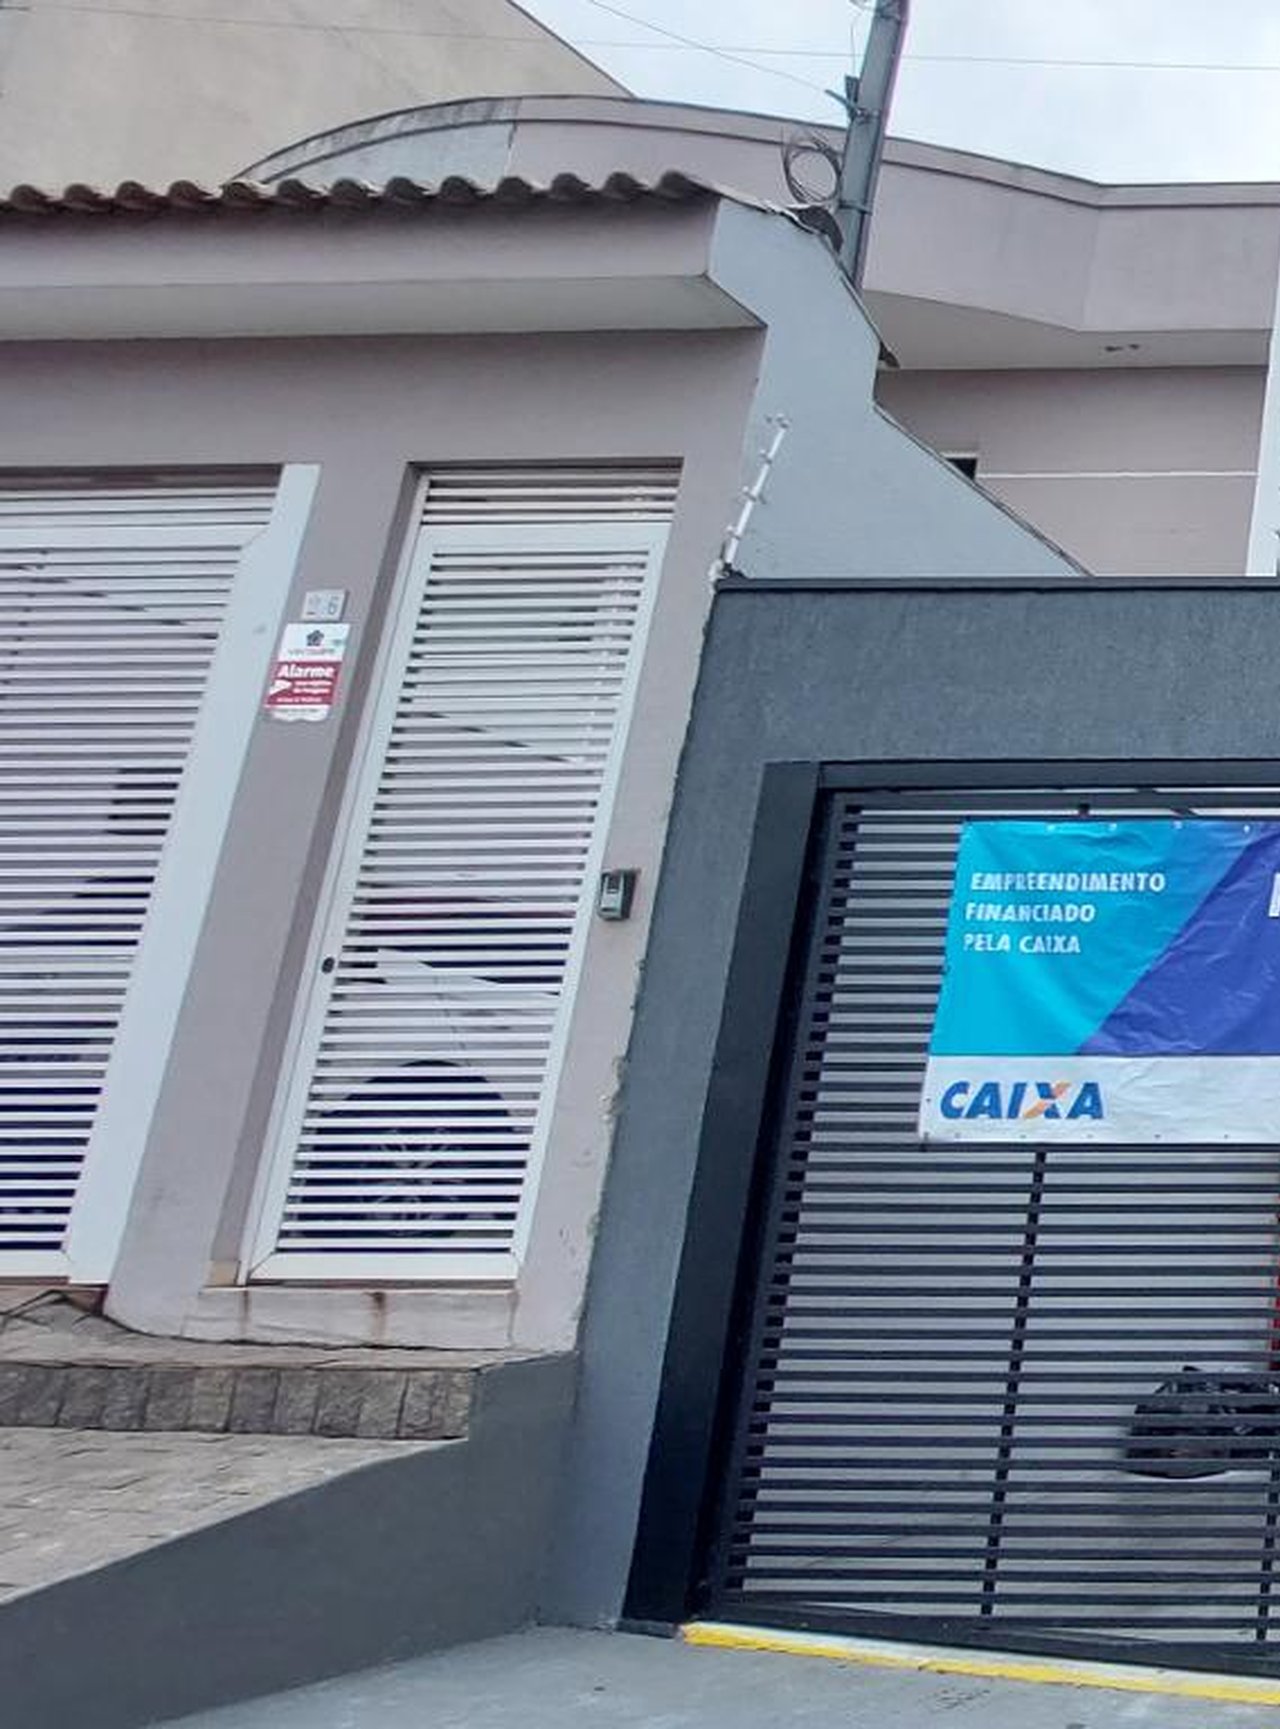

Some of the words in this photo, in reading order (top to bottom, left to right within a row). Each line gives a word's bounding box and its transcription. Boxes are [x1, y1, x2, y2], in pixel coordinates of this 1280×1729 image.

[277, 663, 335, 678] Alarme
[970, 872, 1166, 892] EMPREENDIMENTO
[965, 902, 1096, 922] FINANCIADO
[963, 934, 1011, 952] PELA
[1019, 935, 1081, 954] CAIXA
[939, 1080, 1104, 1120] CAIXA
